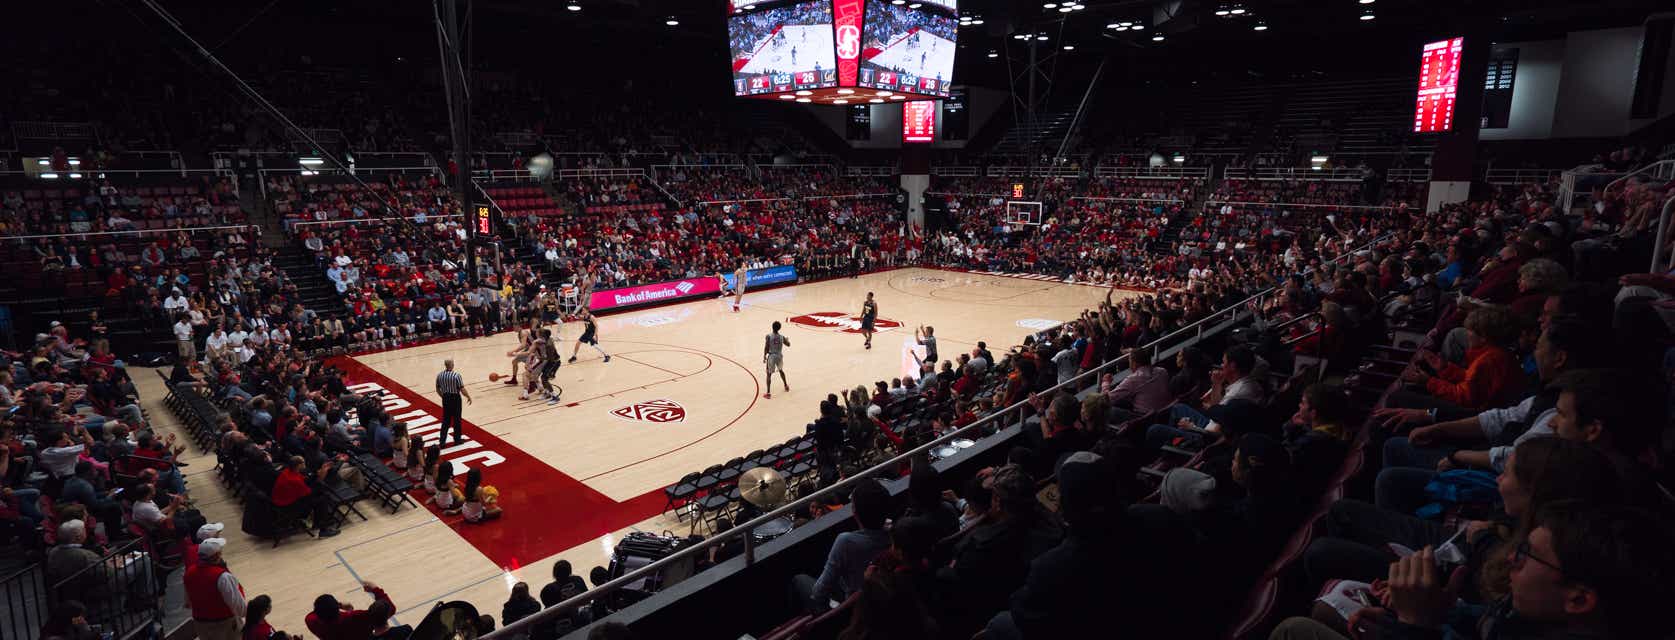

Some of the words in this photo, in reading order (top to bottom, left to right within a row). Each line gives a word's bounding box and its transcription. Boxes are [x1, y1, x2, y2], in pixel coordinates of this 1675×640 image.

[774, 75, 791, 85] 6:25
[802, 73, 814, 83] 26
[880, 73, 890, 83] 22
[901, 76, 916, 86] 6:25
[752, 79, 763, 88] 22
[926, 80, 935, 89] 26
[615, 293, 637, 304] Bank
[637, 291, 645, 301] of
[645, 288, 677, 300] America
